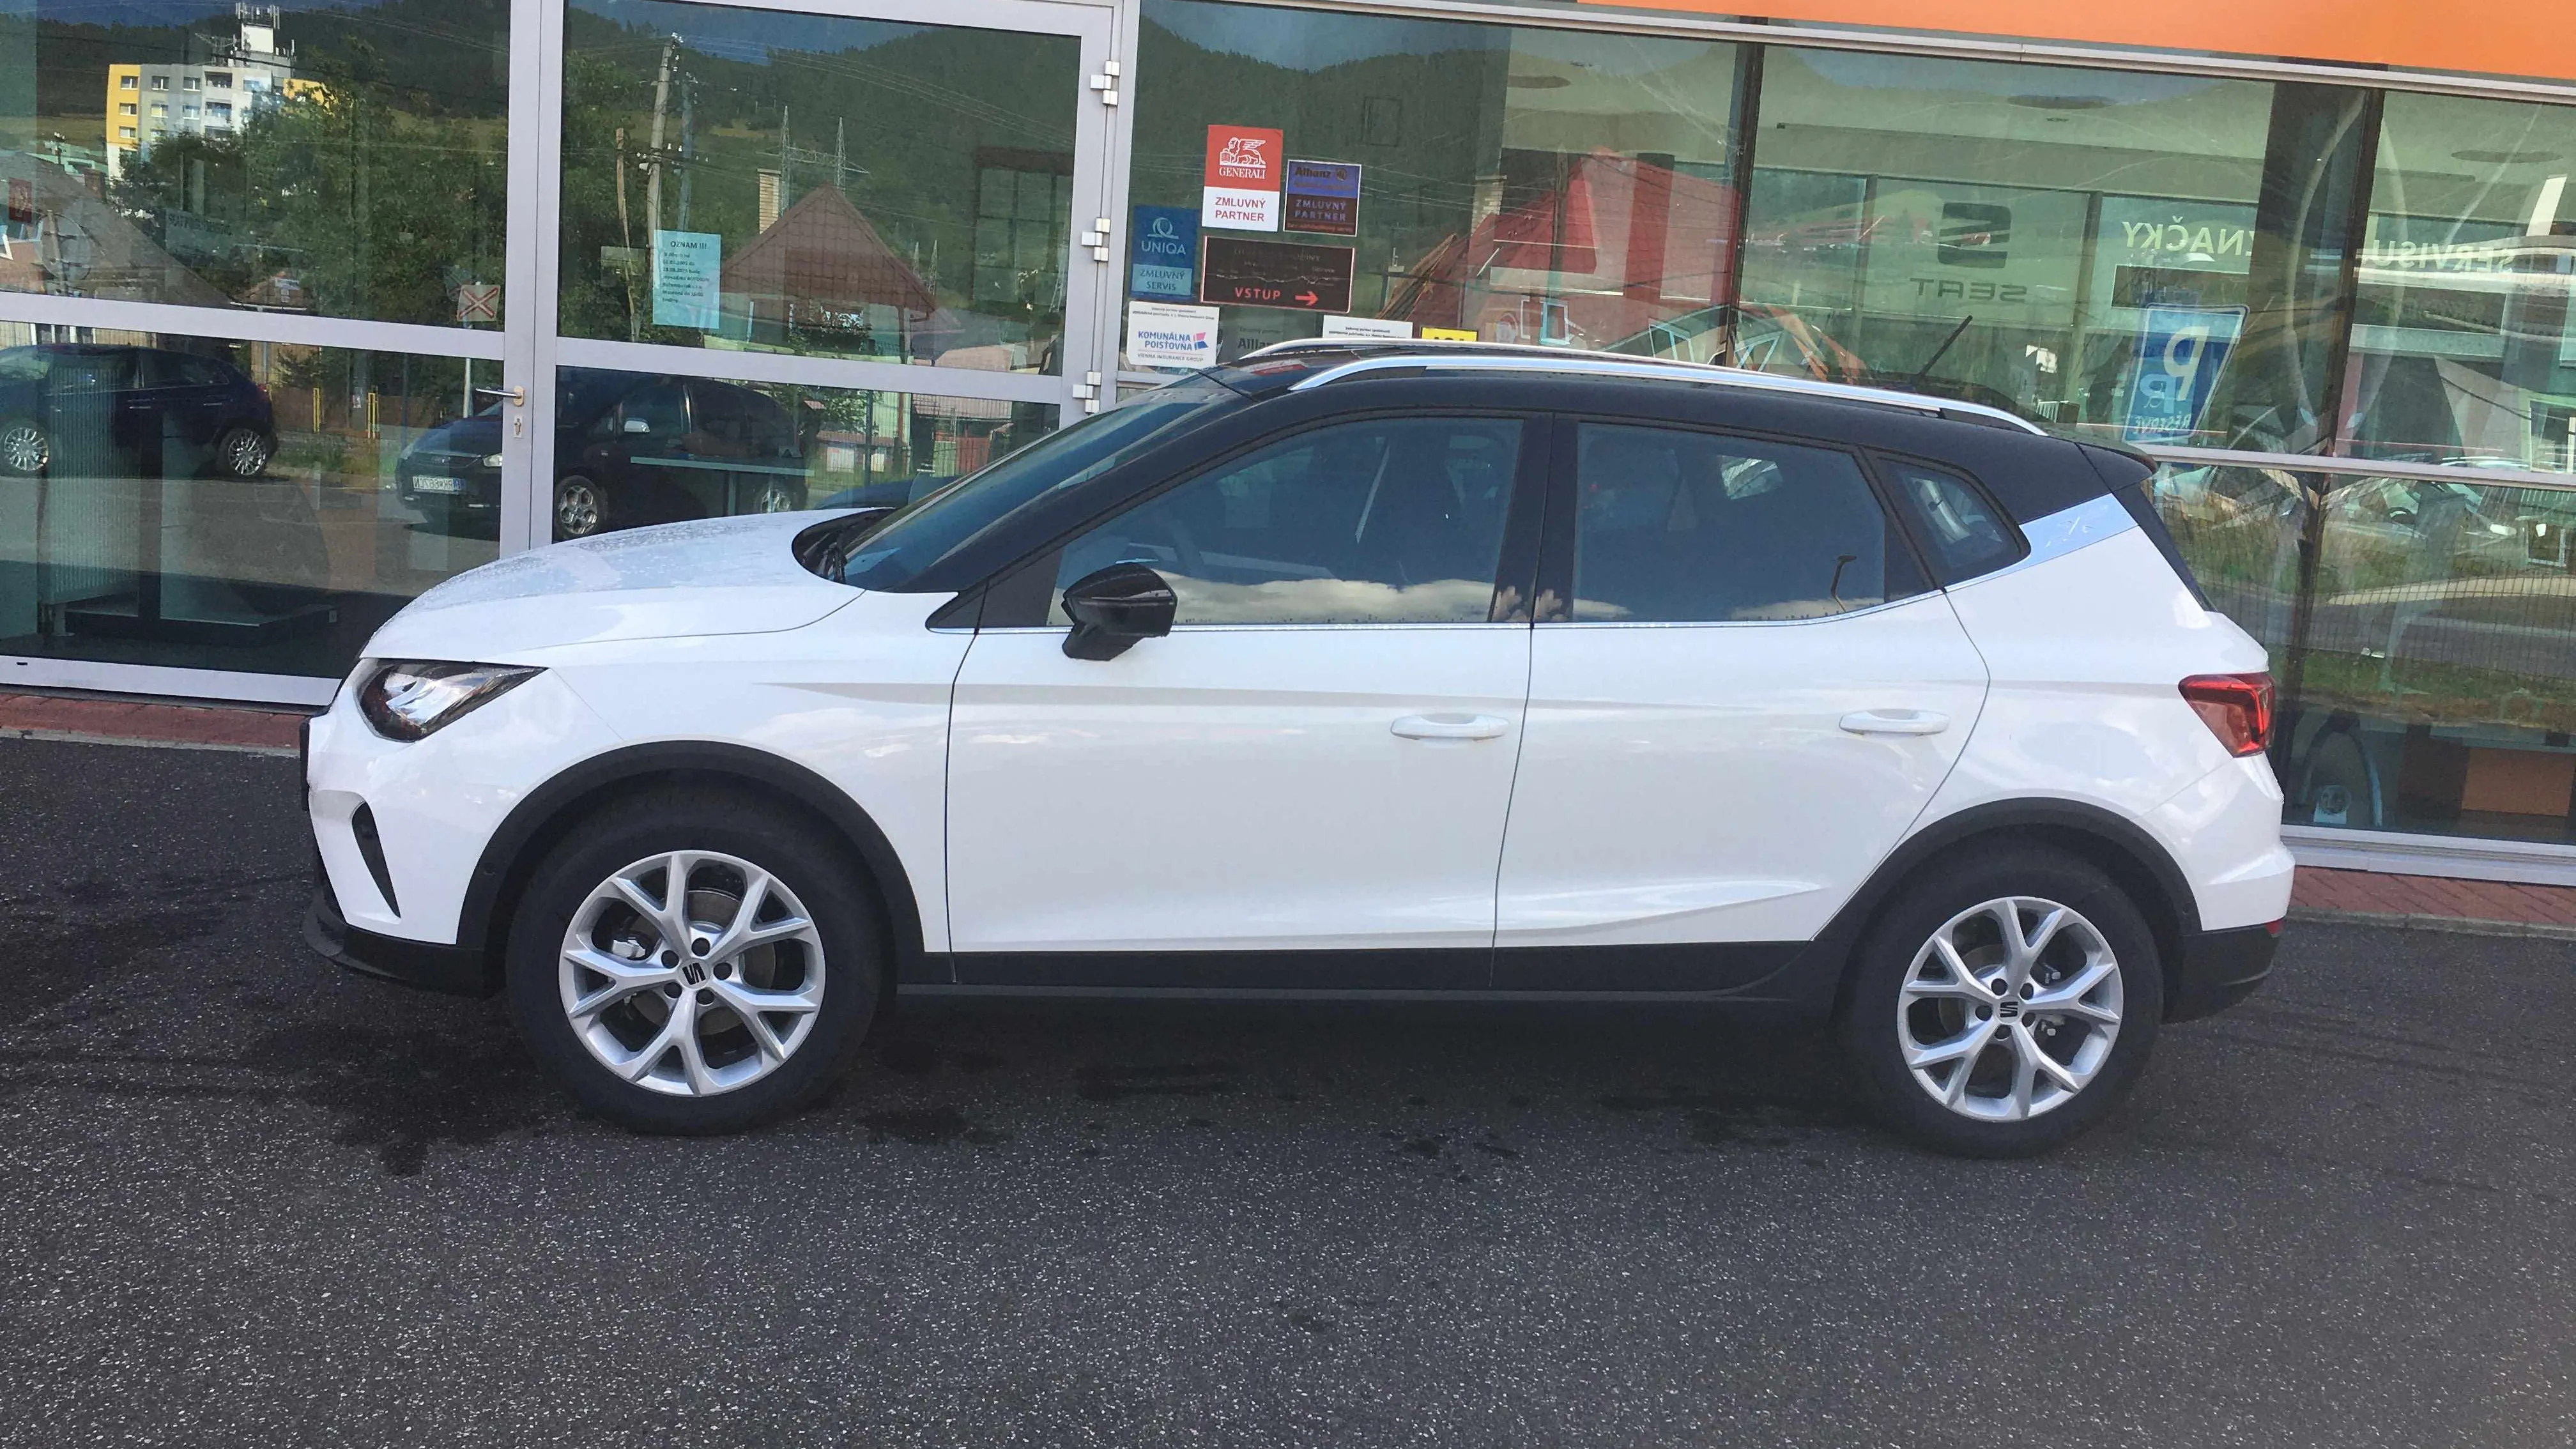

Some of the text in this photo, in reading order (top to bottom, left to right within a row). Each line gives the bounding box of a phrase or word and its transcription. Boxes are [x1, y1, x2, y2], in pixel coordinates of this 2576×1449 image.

[1219, 167, 1266, 179] GENERALI
[1215, 197, 1266, 209] ZMLUVNÝ
[1215, 210, 1265, 222] PARTNER
[1294, 210, 1346, 222] PARTNER
[670, 241, 698, 249] OZNAM
[1141, 241, 1186, 255] UNIQA
[1139, 269, 1186, 280] ZMLUVNÝ
[1146, 281, 1176, 291] SERVIS
[1234, 287, 1282, 301] VSTUP
[1138, 331, 1191, 342] KOMUNÁLNA
